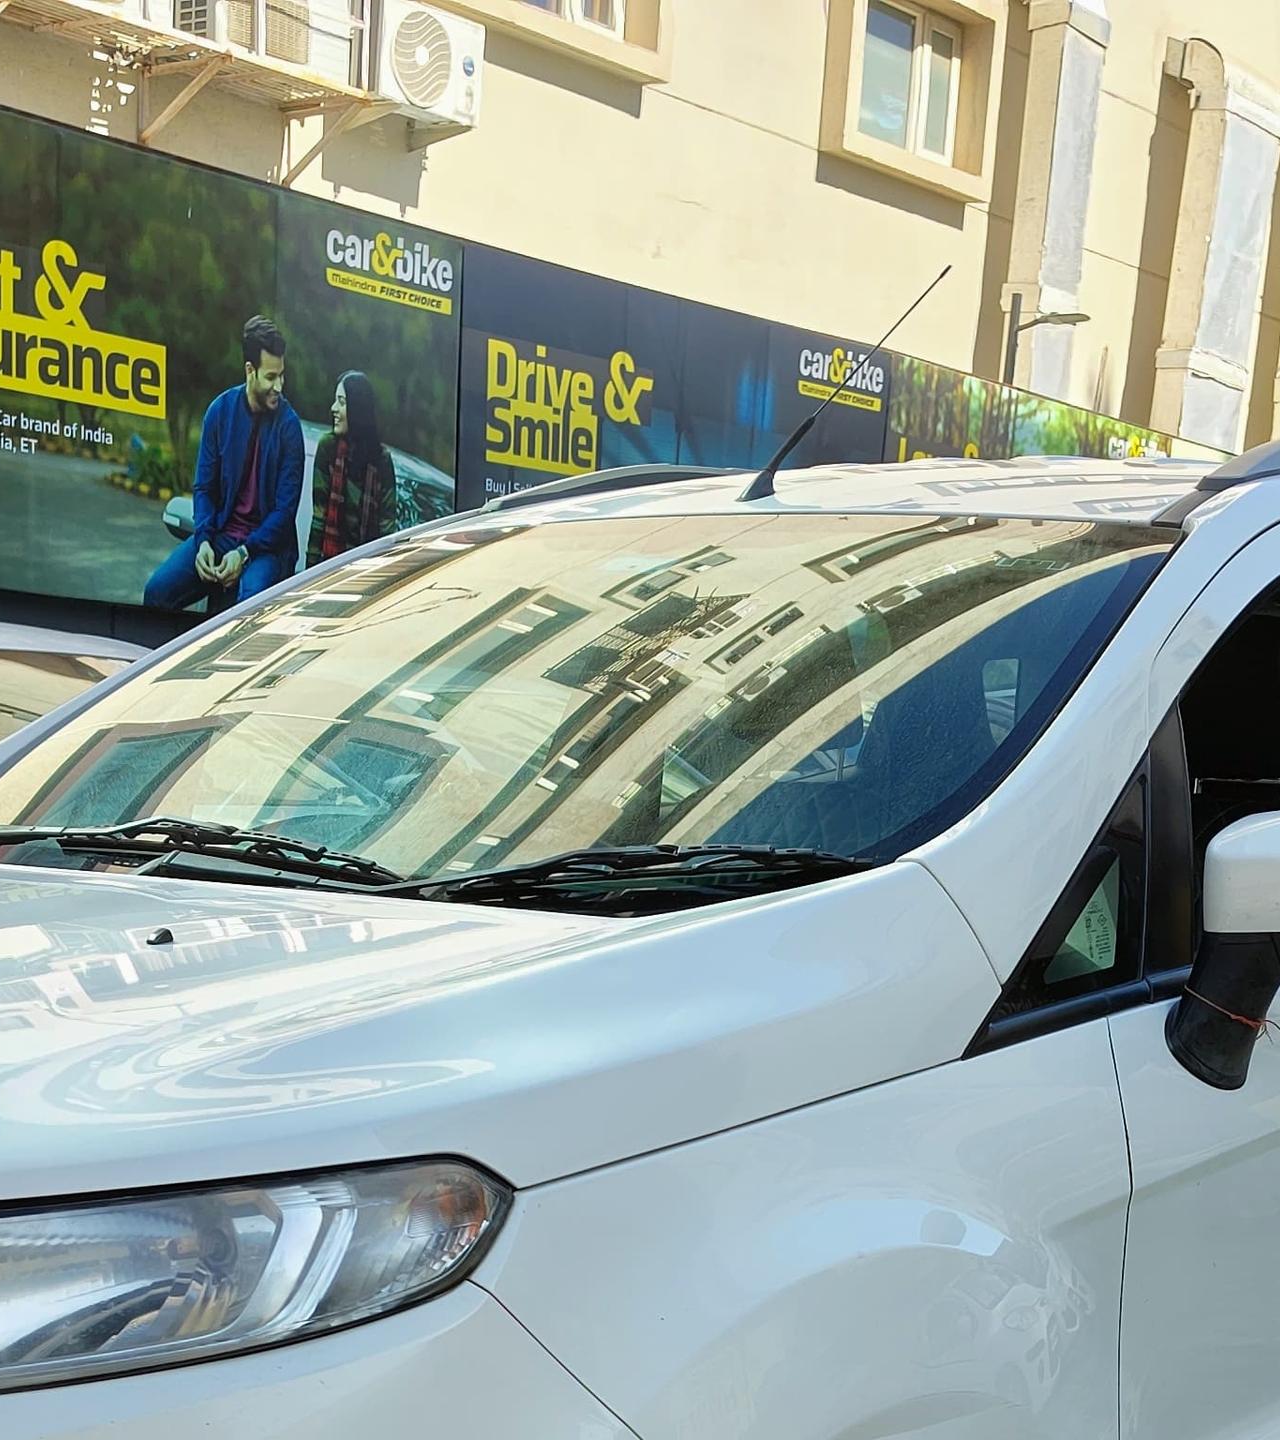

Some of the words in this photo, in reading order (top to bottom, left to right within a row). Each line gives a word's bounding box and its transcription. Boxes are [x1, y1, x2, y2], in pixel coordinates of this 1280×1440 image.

[326, 230, 453, 291] car&bike
[34, 239, 106, 330] &
[380, 286, 408, 299] FIRST
[408, 294, 442, 309] CHOICE
[487, 338, 594, 414] Drive
[604, 351, 654, 425] &
[800, 348, 884, 393] car&bike
[20, 413, 60, 435] brand
[63, 422, 78, 438] of
[81, 424, 113, 445] India
[20, 437, 38, 454] ET
[486, 397, 594, 467] Smile
[485, 478, 506, 496] Buy
